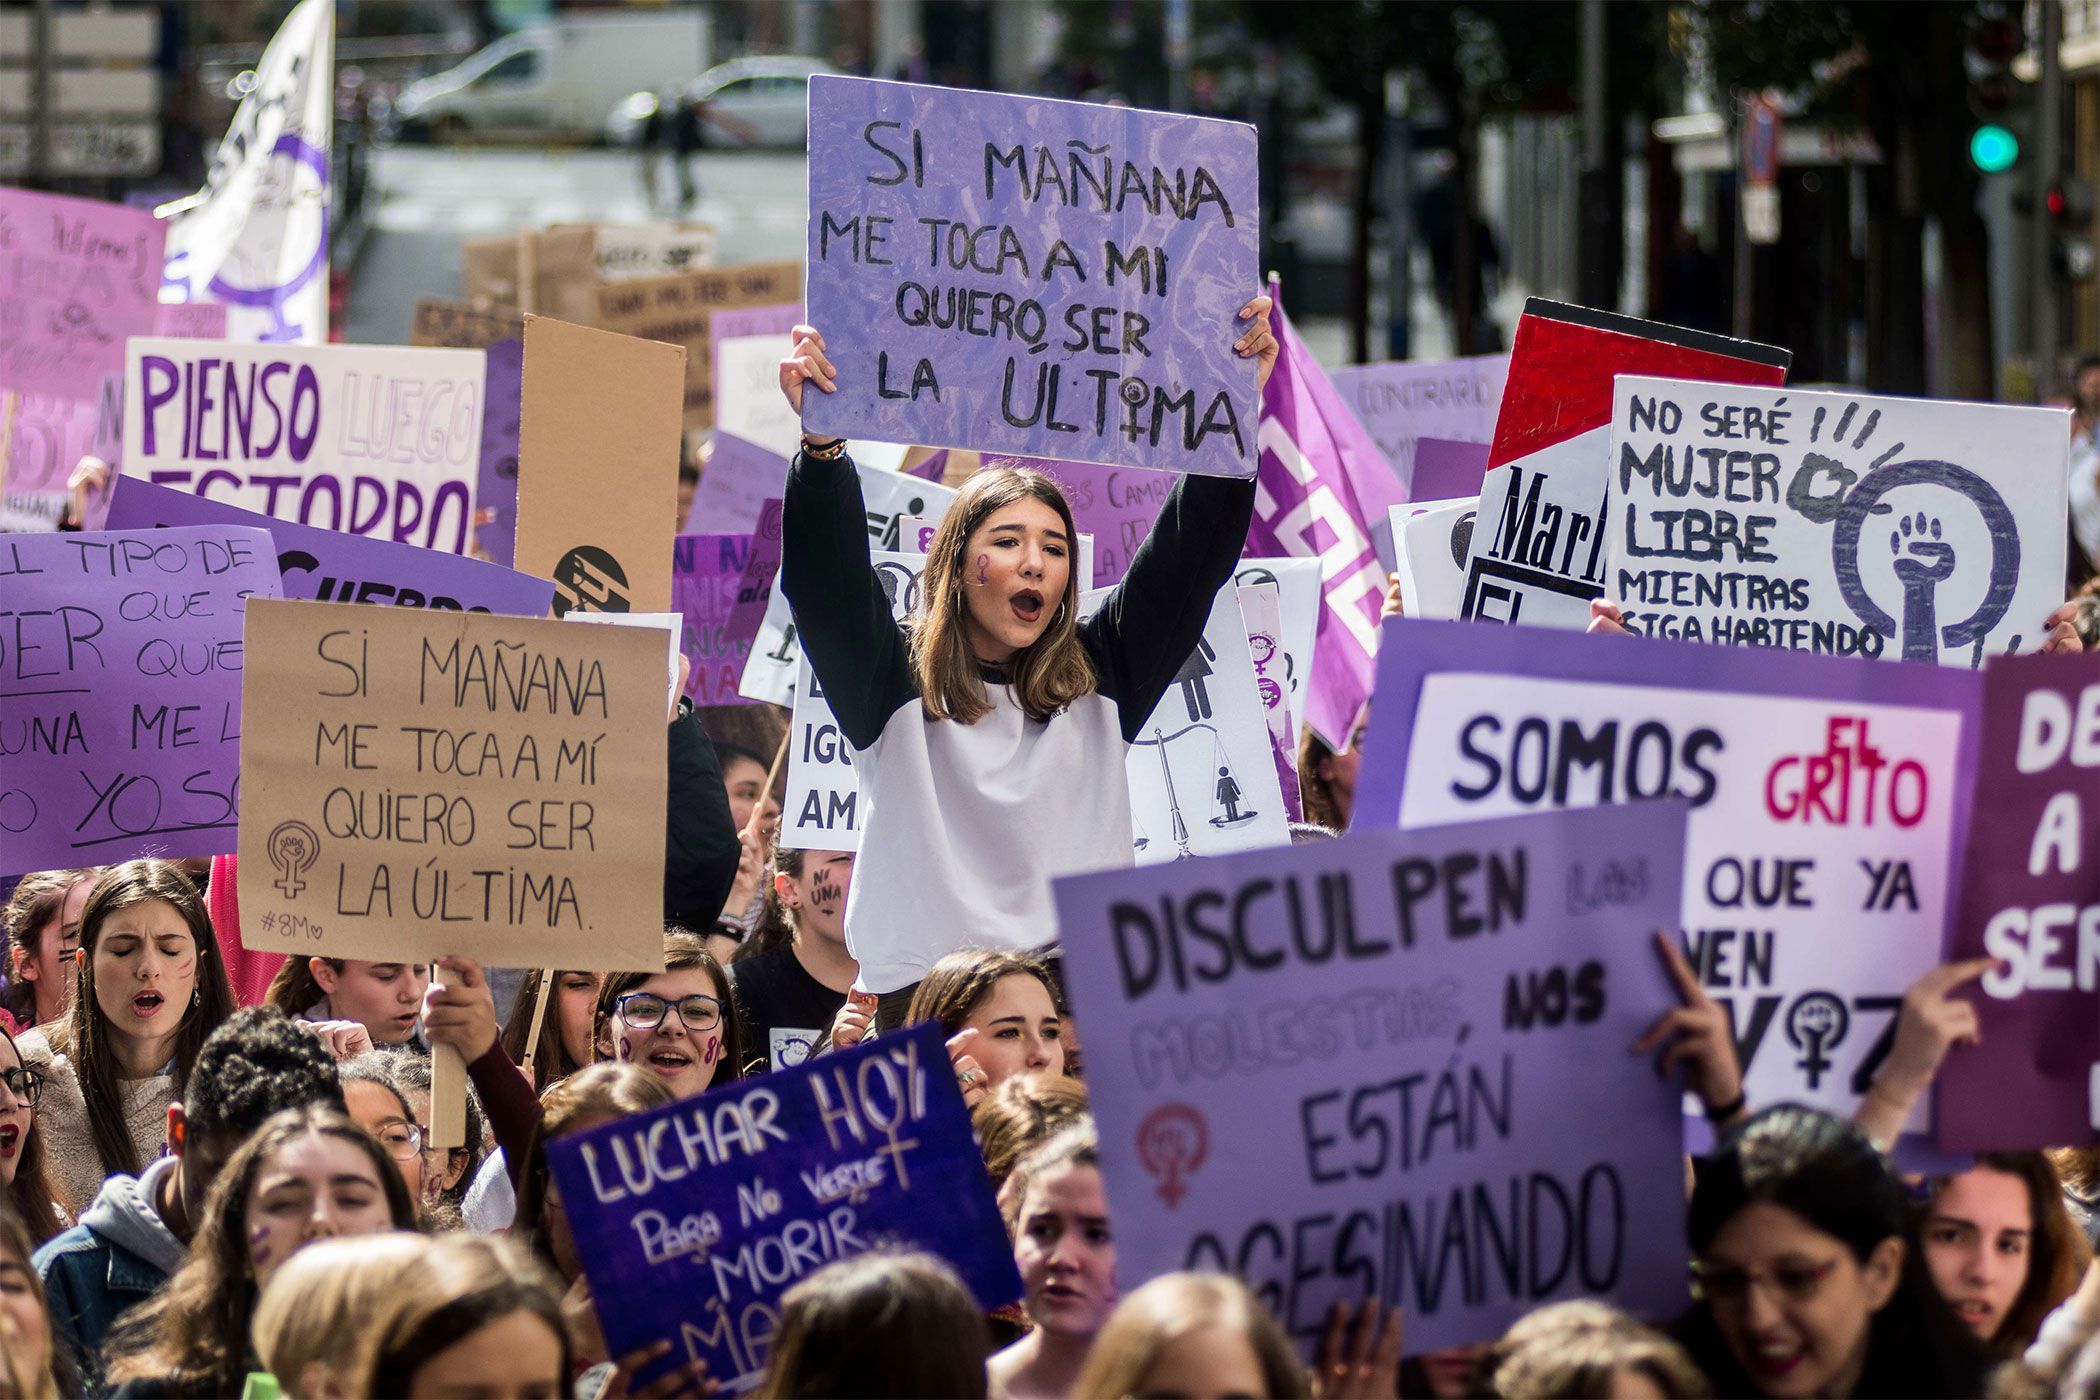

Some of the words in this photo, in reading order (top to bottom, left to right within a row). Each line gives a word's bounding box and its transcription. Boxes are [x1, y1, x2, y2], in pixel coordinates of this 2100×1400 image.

[864, 120, 924, 188] SI
[984, 140, 1235, 228] MAÑANA
[821, 211, 893, 265] ME
[918, 217, 1030, 279] TOCA
[1041, 239, 1087, 282] A
[1105, 240, 1168, 297] MI
[896, 280, 1047, 346] QUIERO
[1063, 303, 1152, 357] SER
[141, 356, 320, 462] PIENSO
[338, 371, 480, 465] LUEGO
[878, 350, 941, 402] LA
[1630, 394, 1683, 435] NO
[1700, 397, 1792, 444] SERÉ
[1619, 442, 1781, 504] MUJER
[66, 538, 188, 577] TIPO
[195, 538, 255, 575] DE
[1625, 502, 1778, 563] LIBRE
[119, 591, 214, 622] QUE
[1618, 568, 1810, 613] MIENTRAS
[0, 606, 105, 680] ER
[1621, 610, 1705, 645] SIGA
[1711, 614, 1884, 660] HABIENDO
[317, 629, 368, 699] SI
[419, 639, 608, 719] MAÑANA
[131, 703, 200, 750] ME
[315, 723, 379, 771] ME
[401, 726, 501, 779] TOCA
[512, 729, 541, 783] A
[555, 733, 607, 786] MÍ
[1449, 713, 1725, 809] SOMOS
[74, 770, 162, 835] YO
[181, 770, 239, 827] S
[322, 787, 476, 846] QUIERO
[506, 800, 596, 853] SER
[797, 789, 860, 831] AM
[1765, 752, 1929, 830] GRITO
[2027, 791, 2082, 877] A
[336, 863, 394, 918] LA
[411, 857, 594, 931] ÚLTIMA.
[810, 884, 842, 906] UNA
[1705, 857, 1815, 911] QUE
[1858, 858, 1920, 911] YA
[1108, 845, 1529, 1000] DISCULPEN
[1502, 960, 1608, 1034] NOS
[579, 1087, 790, 1203] LUCHAR
[808, 1038, 927, 1191] HOY
[1300, 1025, 1515, 1187] ESTÁN
[711, 1205, 868, 1303] MORIR
